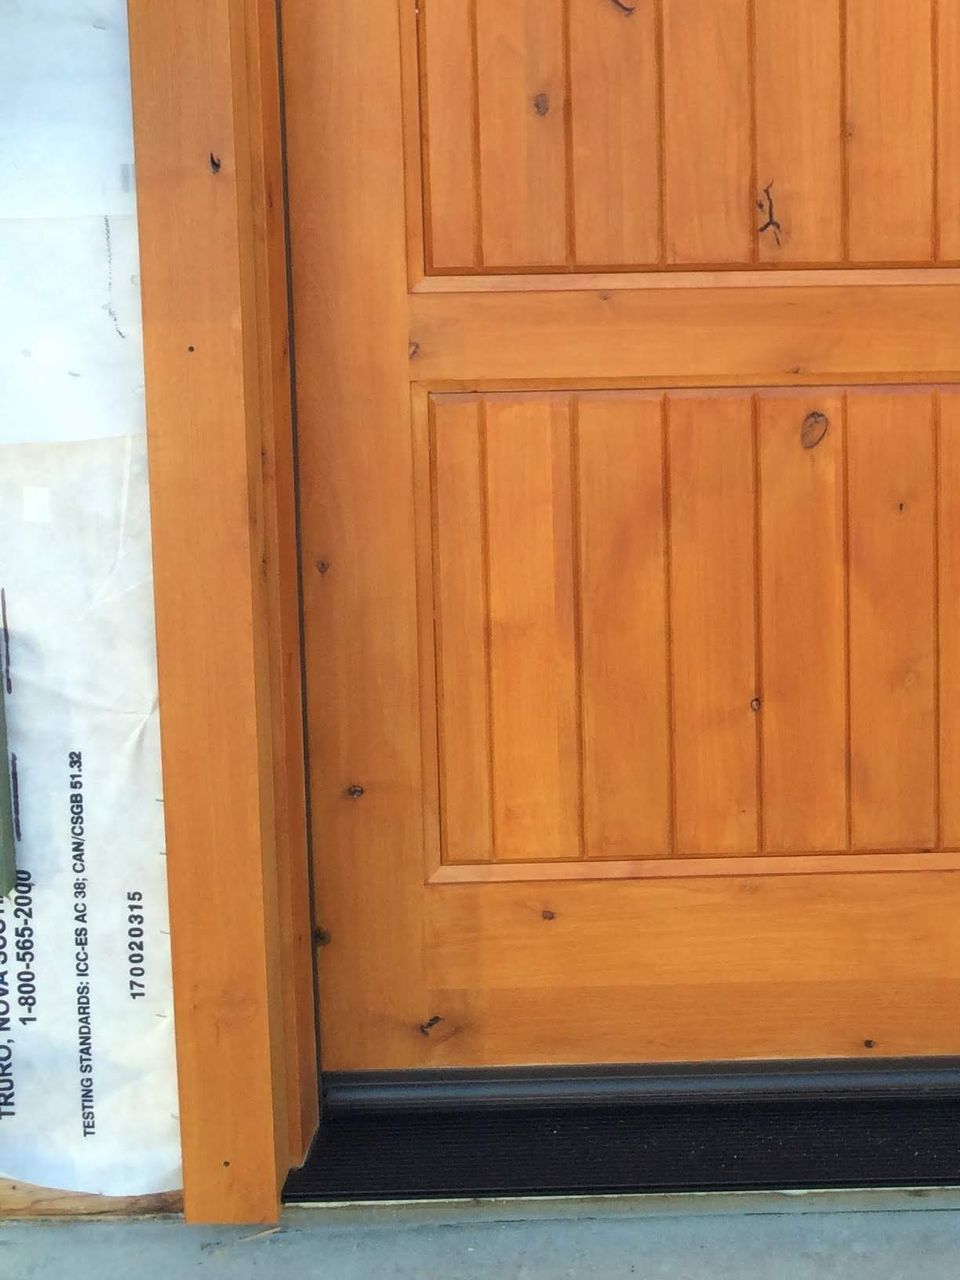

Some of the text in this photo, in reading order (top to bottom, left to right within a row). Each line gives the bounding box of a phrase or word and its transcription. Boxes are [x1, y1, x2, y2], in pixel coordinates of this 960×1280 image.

[14, 870, 37, 1026] 1-800-565-2000
[69, 751, 96, 1138] TESTING STANDARDS: ICC-ES AC 38; CAN/CSGB 51.32
[127, 891, 146, 1000] 170020315
